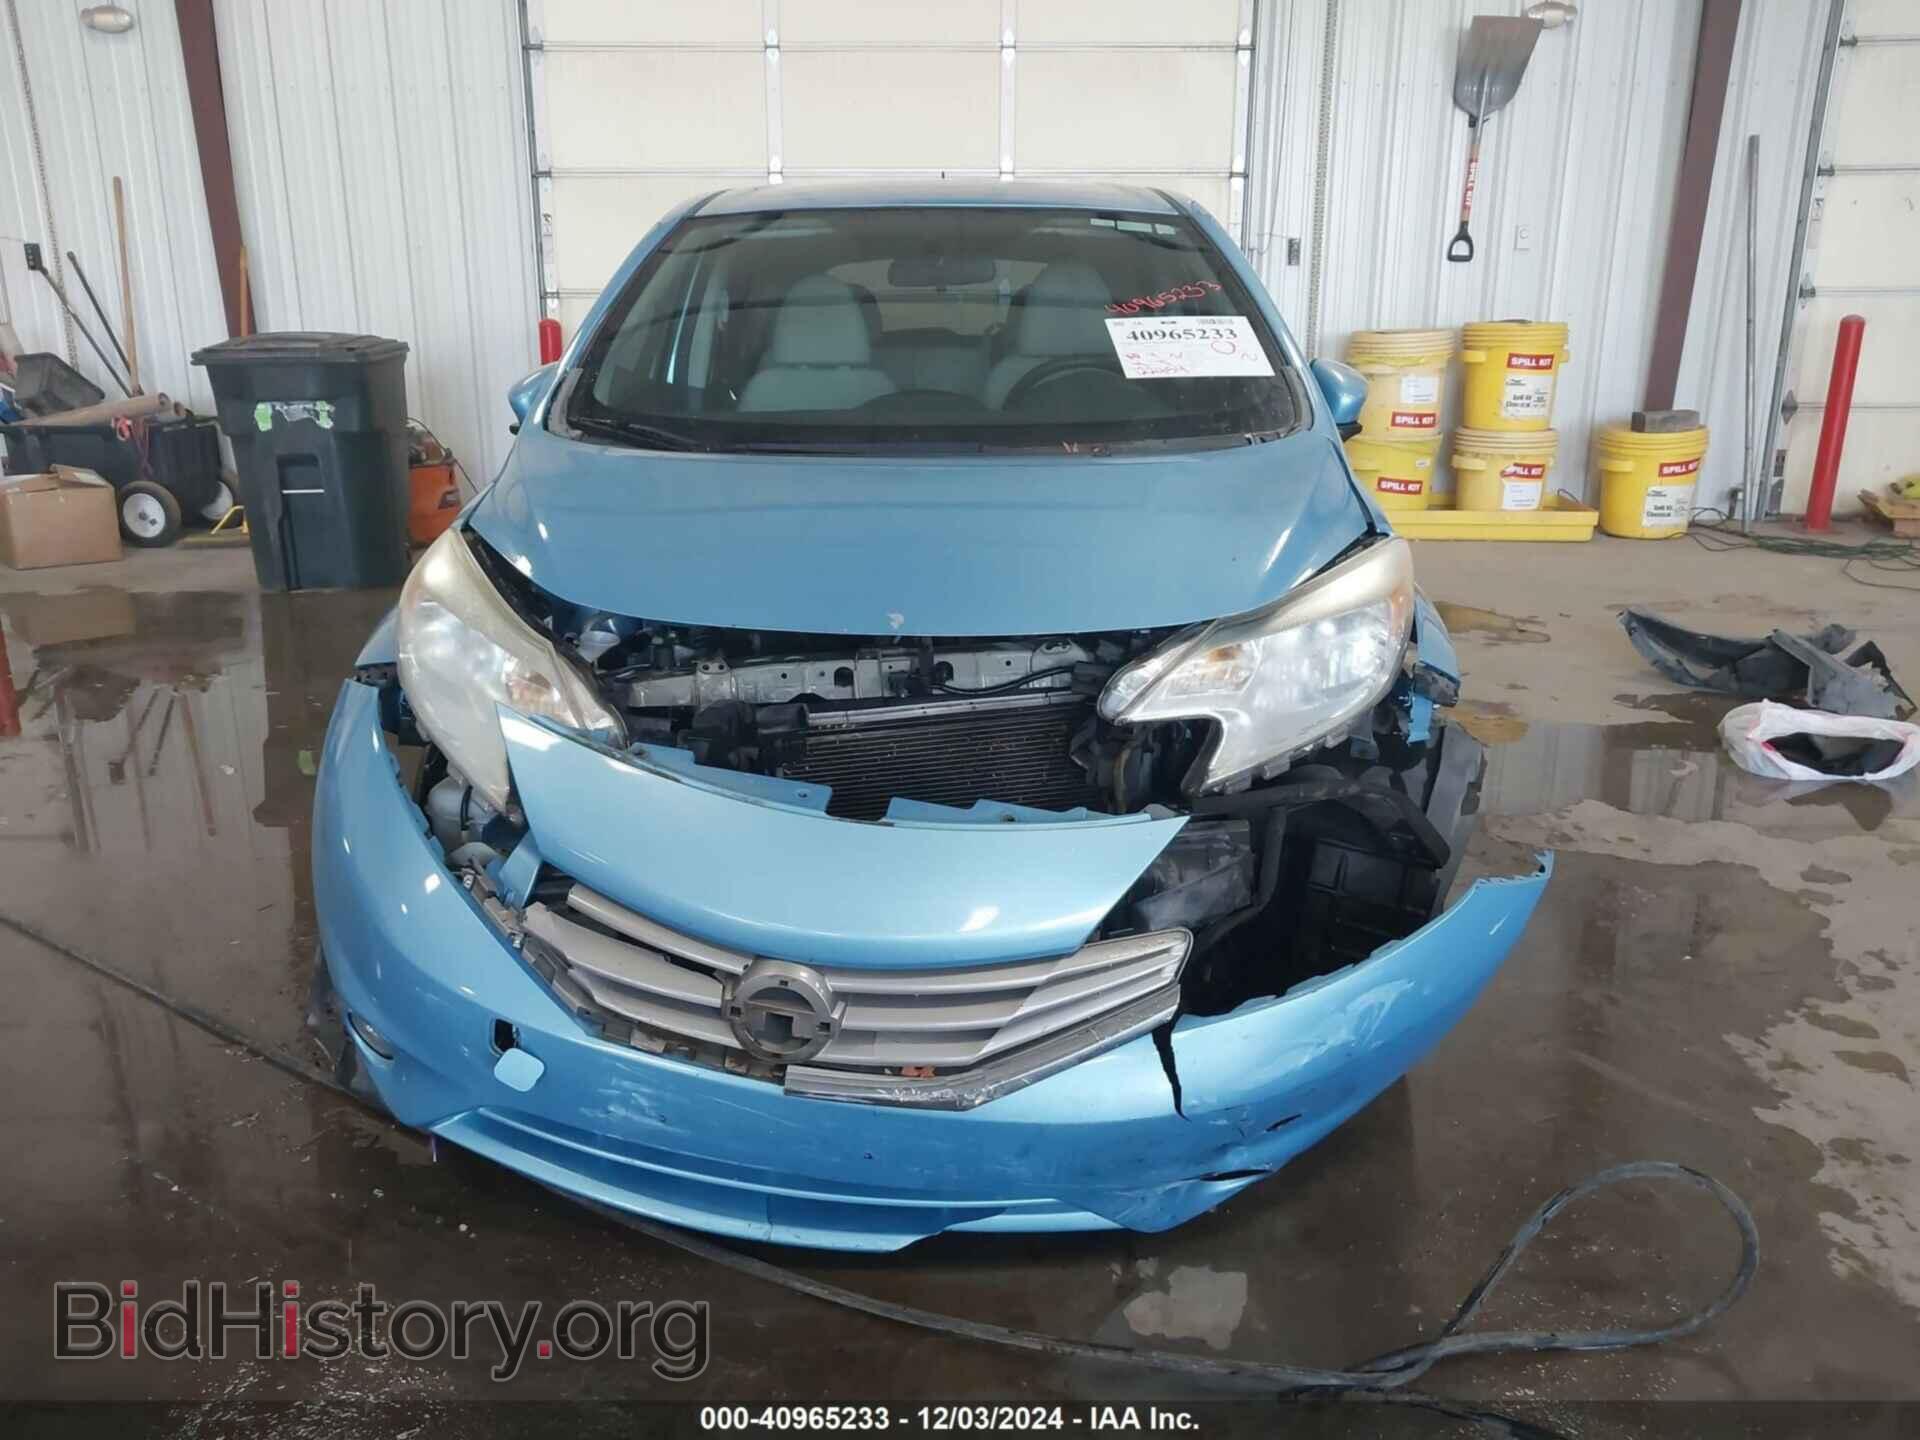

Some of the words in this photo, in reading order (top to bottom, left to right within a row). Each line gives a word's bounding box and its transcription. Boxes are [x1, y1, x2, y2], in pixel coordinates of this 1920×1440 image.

[1126, 327, 1238, 341] 40965233
[1510, 356, 1537, 367] SPILL
[1538, 357, 1553, 367] KIT
[1394, 415, 1420, 425] SPILL
[1421, 416, 1434, 425] KIT
[1530, 467, 1543, 476] KIT
[1662, 464, 1687, 475] SPILL
[1380, 480, 1406, 491] SPILL
[1407, 482, 1422, 493] KIT
